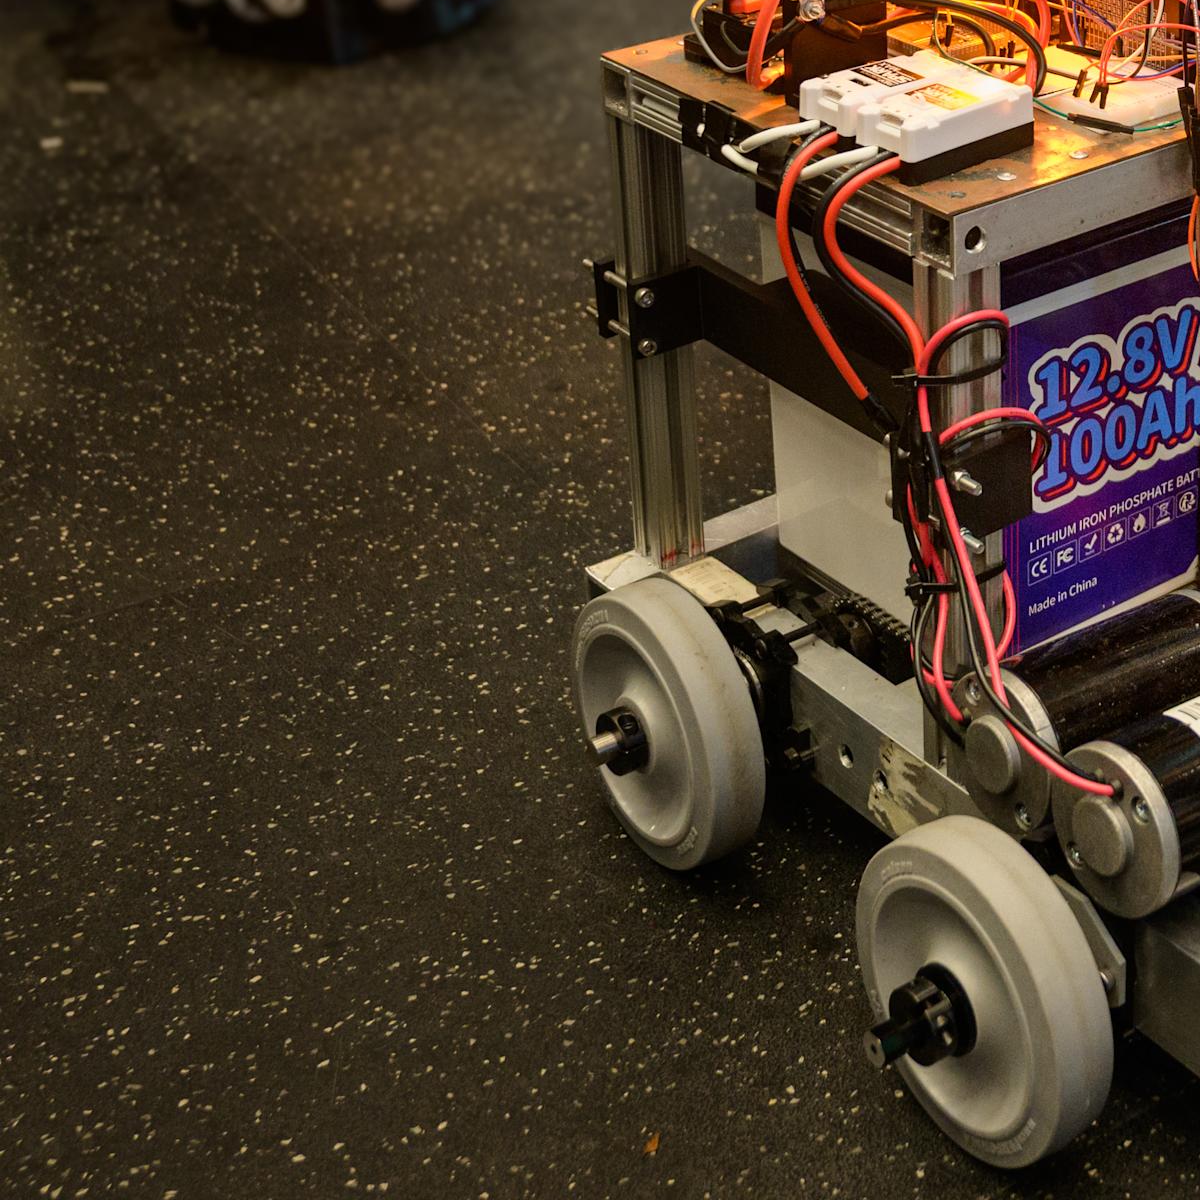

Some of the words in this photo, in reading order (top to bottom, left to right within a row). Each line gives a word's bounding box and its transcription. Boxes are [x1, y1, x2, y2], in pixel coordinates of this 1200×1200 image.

[1035, 306, 1199, 426] 12.8V
[1029, 522, 1076, 554] LITHIUM
[1079, 510, 1107, 531] IRON
[1109, 479, 1174, 518] PHOSPHATE
[1028, 597, 1056, 616] Made
[1058, 589, 1067, 603] in
[1069, 576, 1098, 597] China
